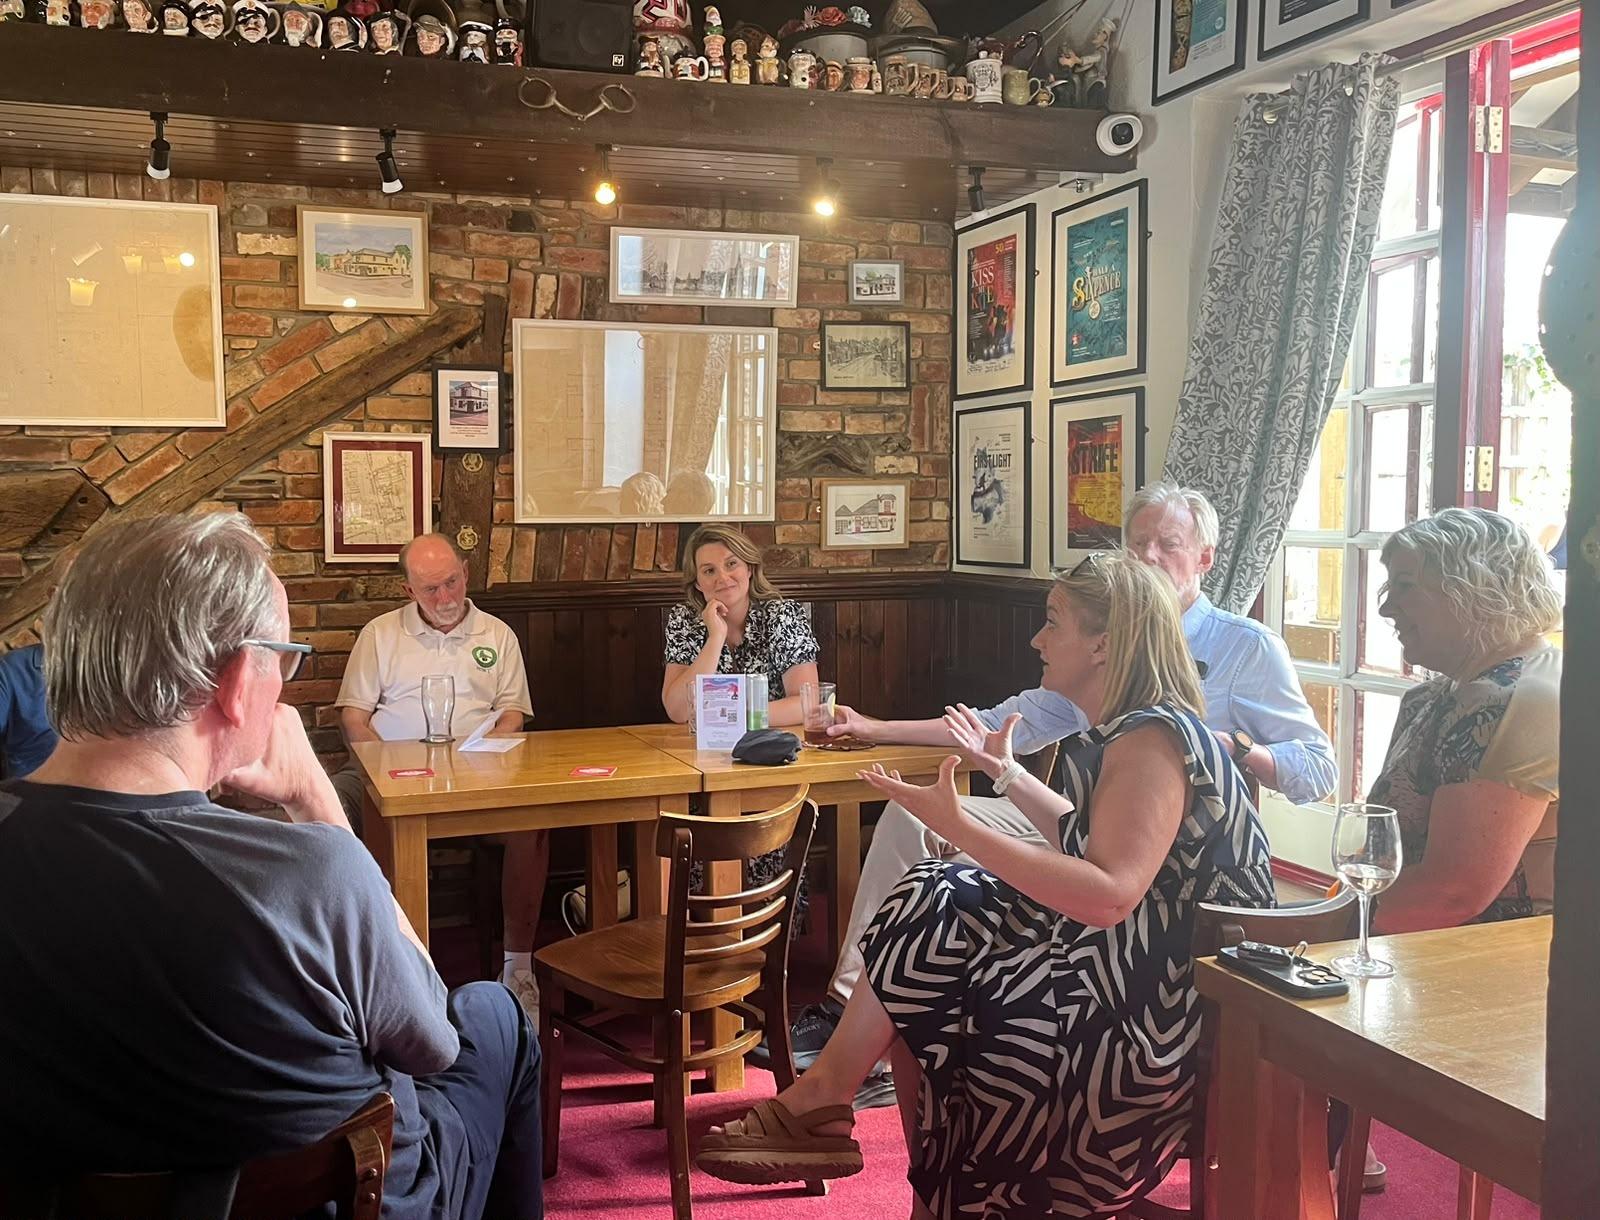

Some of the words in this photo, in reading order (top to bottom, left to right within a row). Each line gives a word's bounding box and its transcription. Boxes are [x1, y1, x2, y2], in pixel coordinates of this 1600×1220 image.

[971, 265, 994, 289] KISS
[974, 454, 991, 469] FIRST
[993, 453, 1011, 468] LIGHT
[1070, 443, 1118, 474] STRIFE
